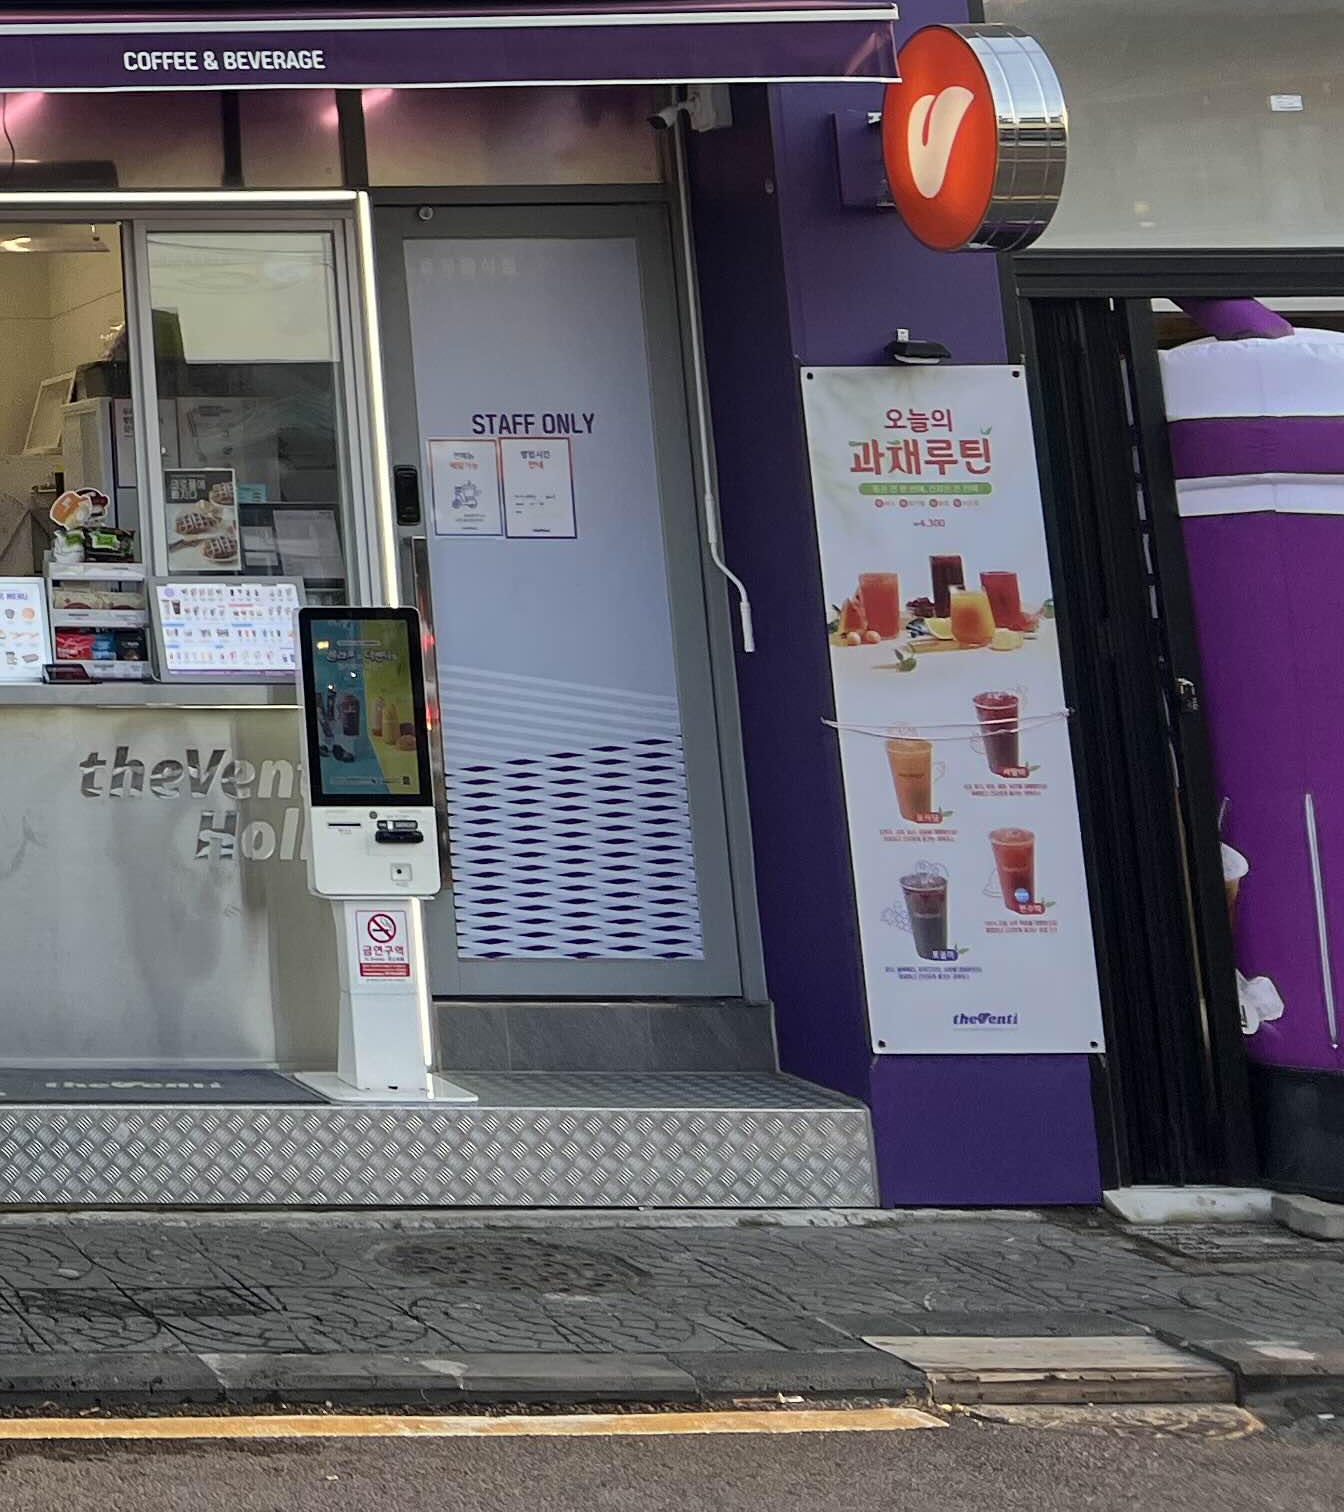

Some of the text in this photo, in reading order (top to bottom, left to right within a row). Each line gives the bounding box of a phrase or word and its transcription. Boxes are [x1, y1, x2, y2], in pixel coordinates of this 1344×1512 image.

[123, 50, 327, 71] COFFEE & BEVERAGE
[472, 412, 596, 435] STAFF ONLY
[884, 408, 953, 433] 오늘의
[848, 438, 993, 476] 과채루틴
[362, 945, 404, 957] 금연구역
